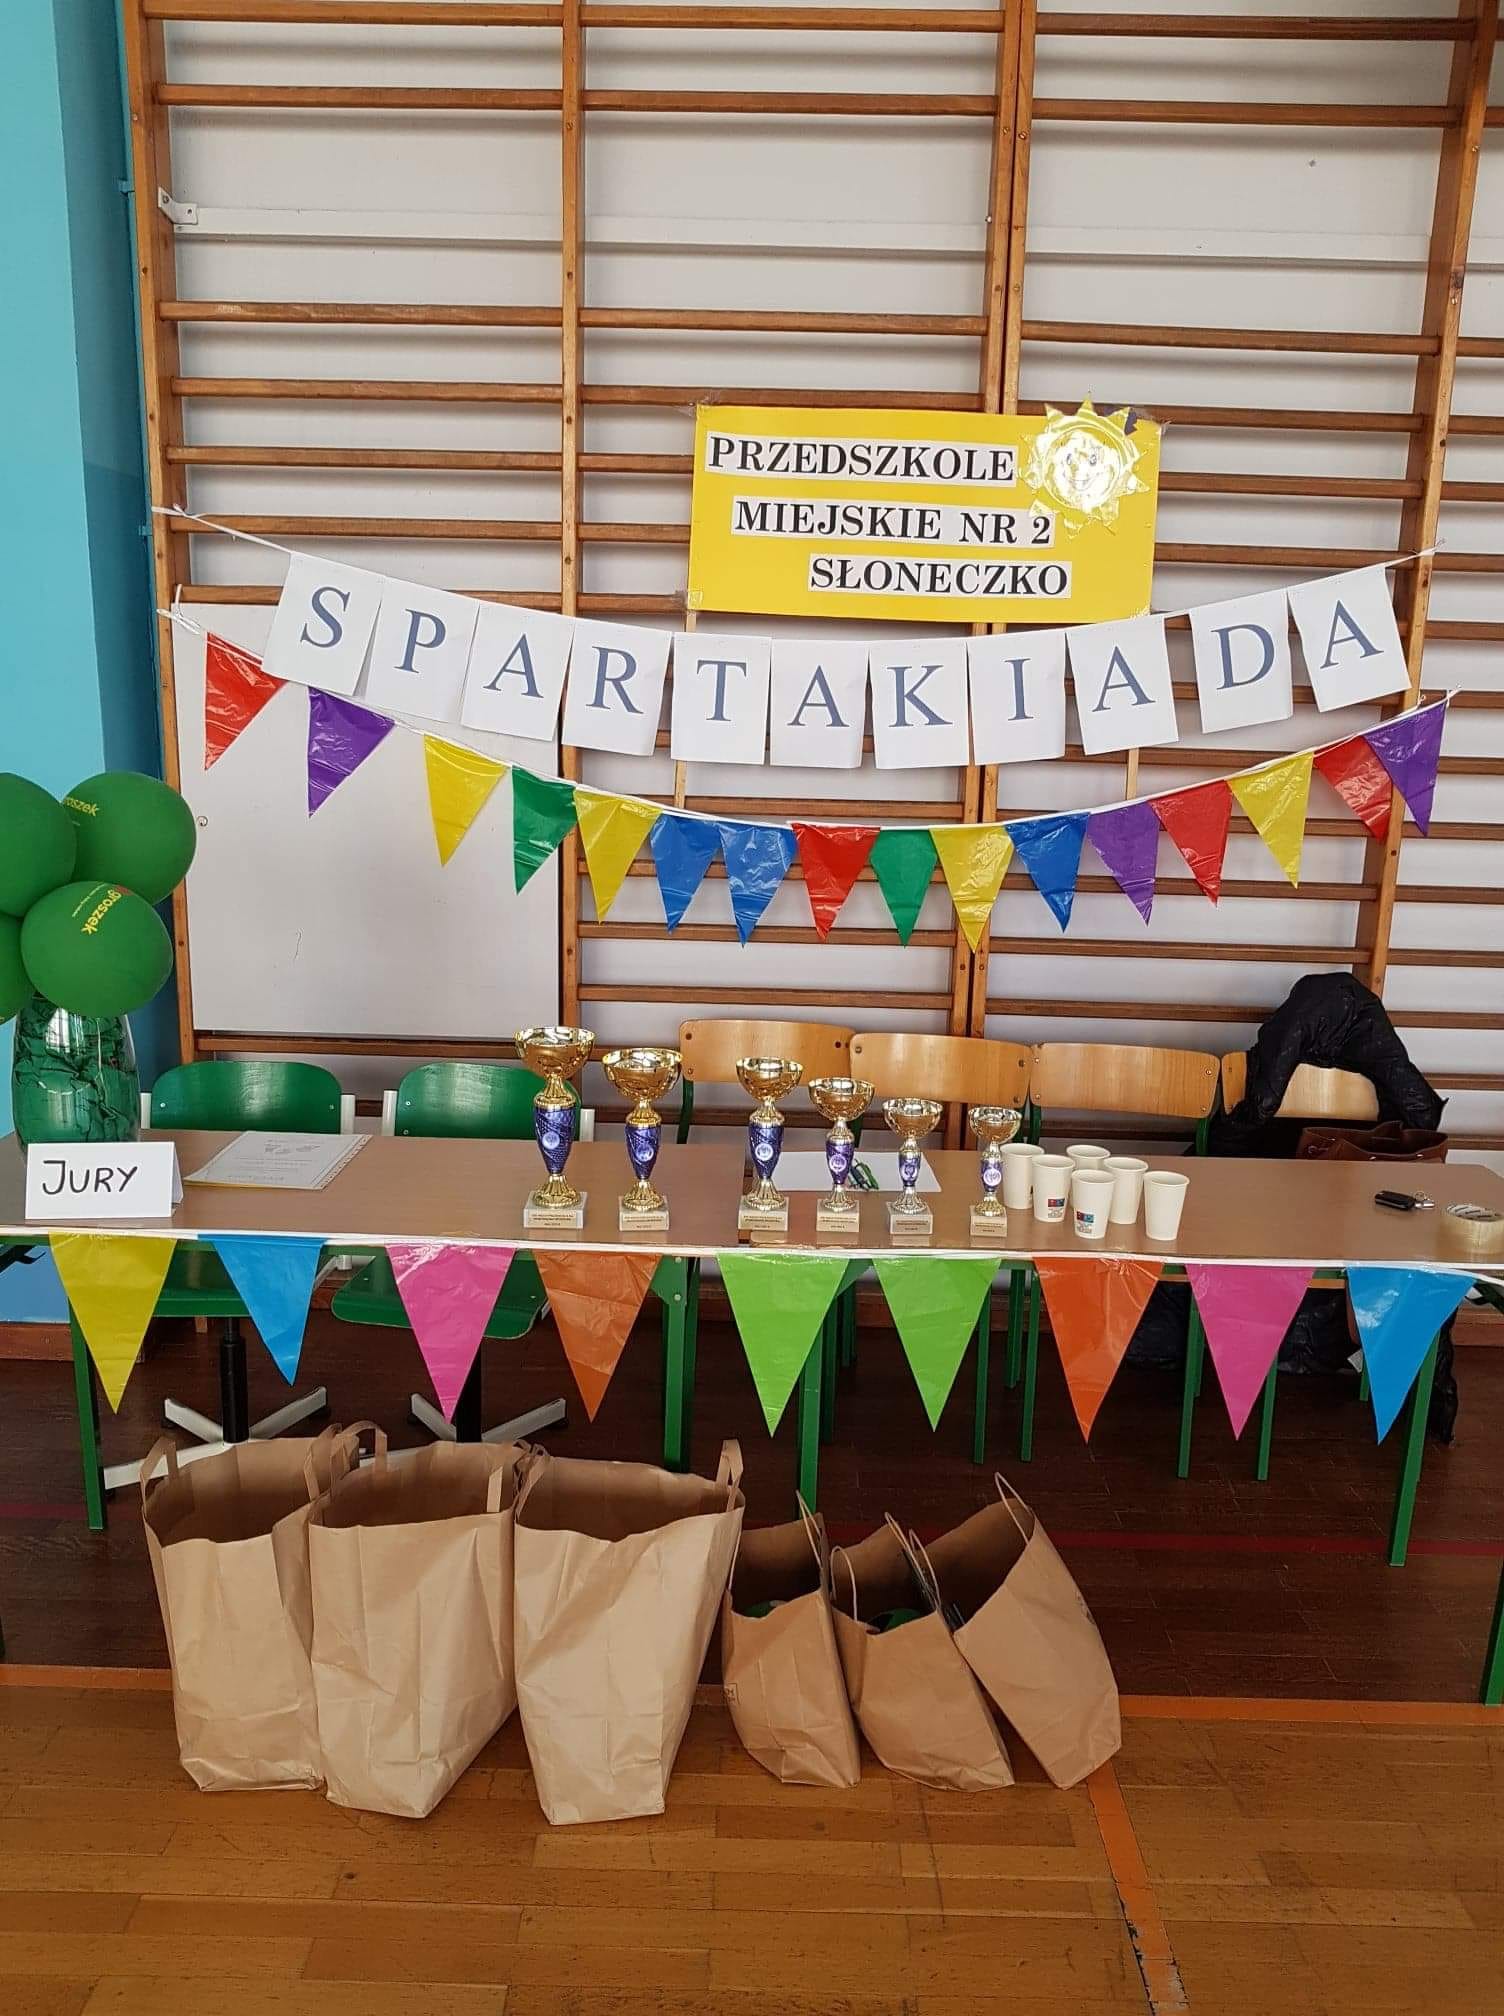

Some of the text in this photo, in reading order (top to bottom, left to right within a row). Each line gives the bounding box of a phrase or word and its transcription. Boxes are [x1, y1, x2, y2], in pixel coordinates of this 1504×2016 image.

[708, 436, 1013, 481] PRZEDSZKOLE
[735, 501, 1051, 544] MIEJSKIE NR 2
[811, 558, 1067, 595] SŁONECZKO
[299, 585, 1384, 728] SPARTAKIADA
[81, 889, 122, 934] groszek
[42, 1159, 138, 1194] JURY
